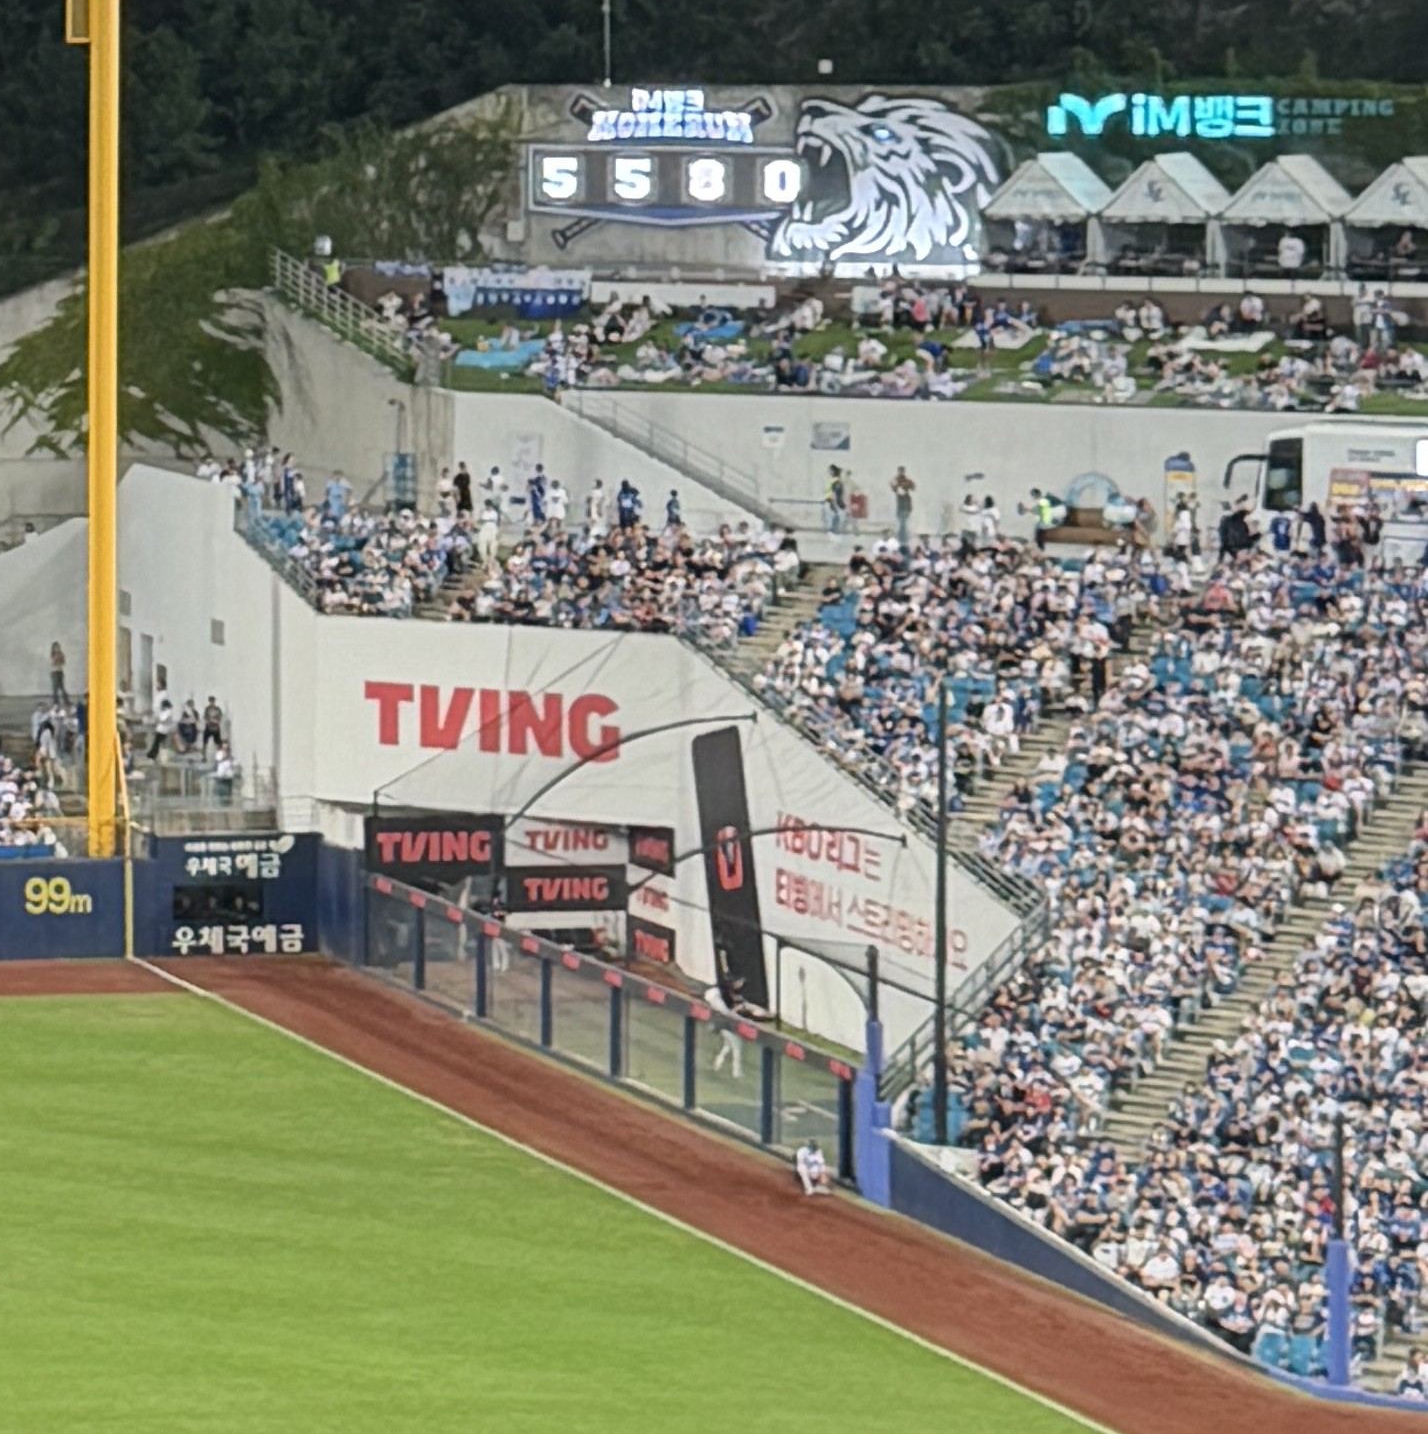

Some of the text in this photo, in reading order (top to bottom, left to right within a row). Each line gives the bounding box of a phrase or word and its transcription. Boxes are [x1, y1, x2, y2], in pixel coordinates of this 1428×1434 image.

[1130, 92, 1396, 139] iM뱅크 CAMPING
[364, 680, 621, 763] TVING
[376, 830, 492, 864] TVING
[525, 827, 609, 852] TVING
[24, 876, 93, 916] 99m
[524, 878, 609, 902] TVING
[171, 923, 305, 956] 우체국예금
